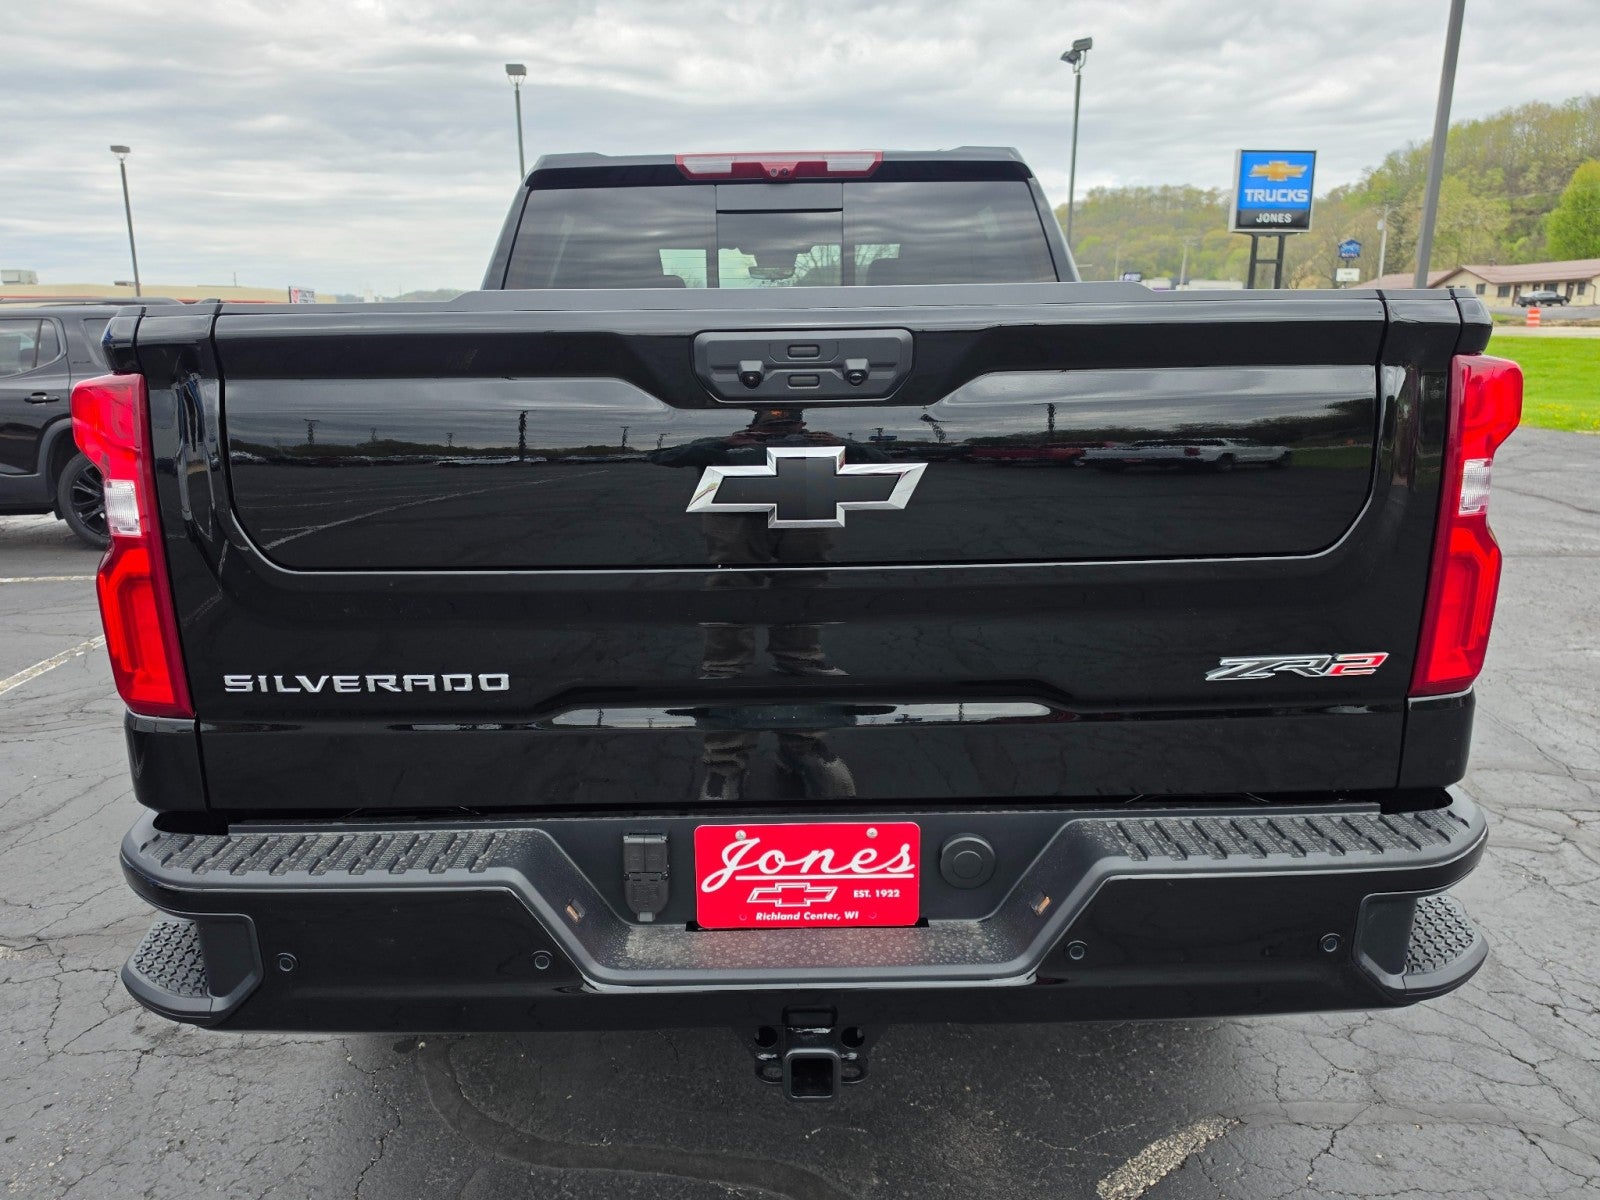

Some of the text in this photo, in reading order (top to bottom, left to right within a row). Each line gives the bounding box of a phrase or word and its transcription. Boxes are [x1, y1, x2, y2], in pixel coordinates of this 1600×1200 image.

[1244, 188, 1309, 203] TRUCKS
[1256, 212, 1292, 224] JONES
[1205, 652, 1389, 681] ZR2
[223, 673, 510, 693] SILVERADO
[701, 837, 915, 892] Jones
[853, 888, 901, 898] EST. 1922
[756, 911, 859, 922] Richland Center, WI
